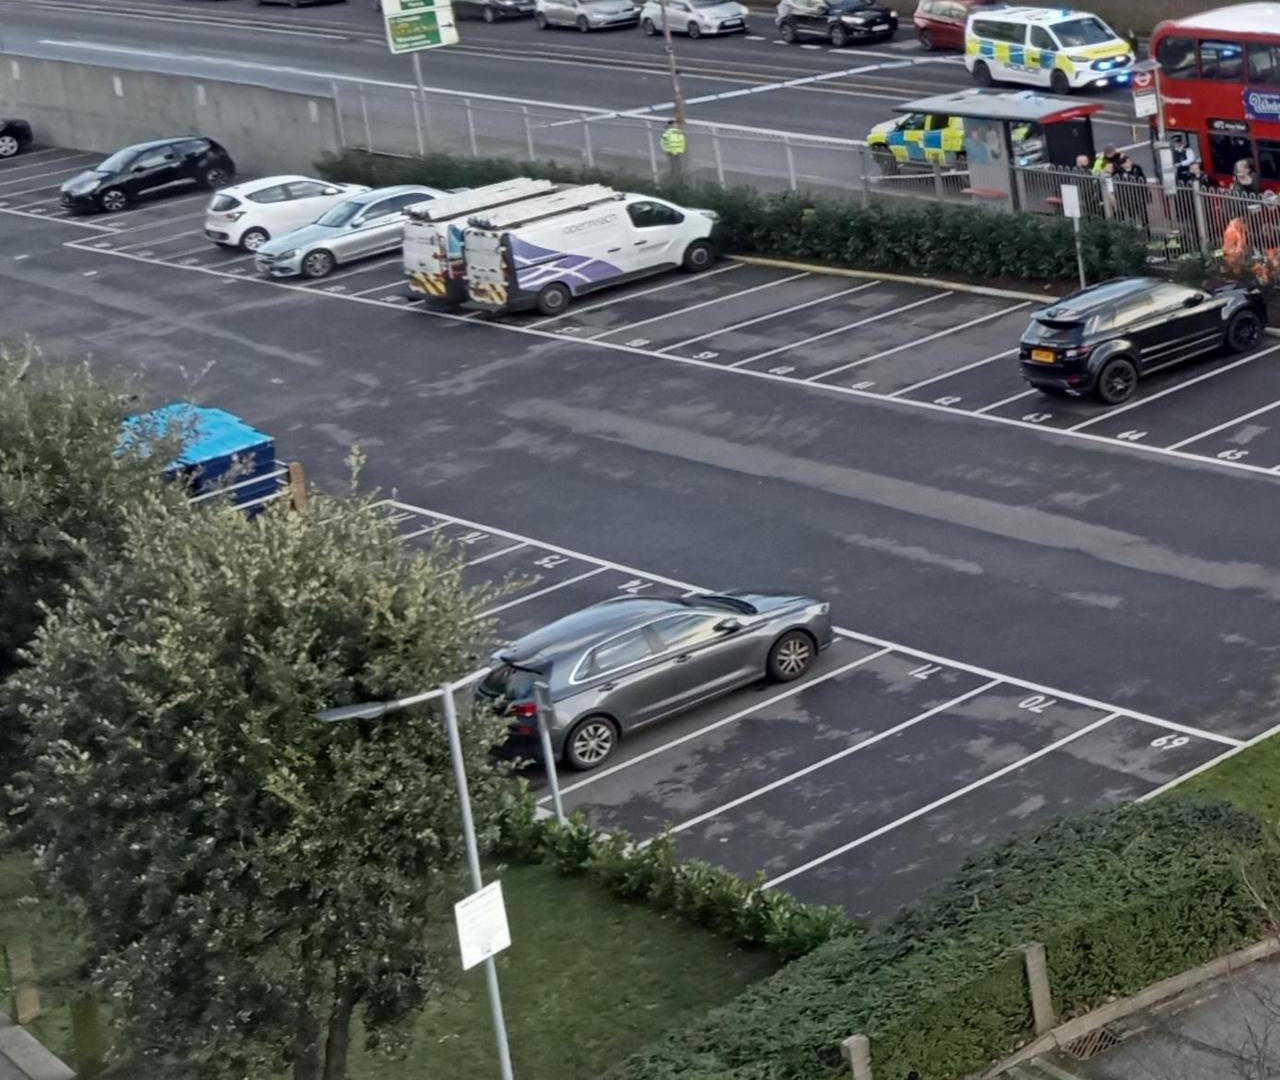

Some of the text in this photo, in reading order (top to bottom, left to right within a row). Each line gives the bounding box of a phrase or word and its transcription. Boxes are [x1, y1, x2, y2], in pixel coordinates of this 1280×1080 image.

[1217, 448, 1249, 460] 65
[1018, 694, 1058, 714] 70
[1150, 733, 1191, 751] 69
